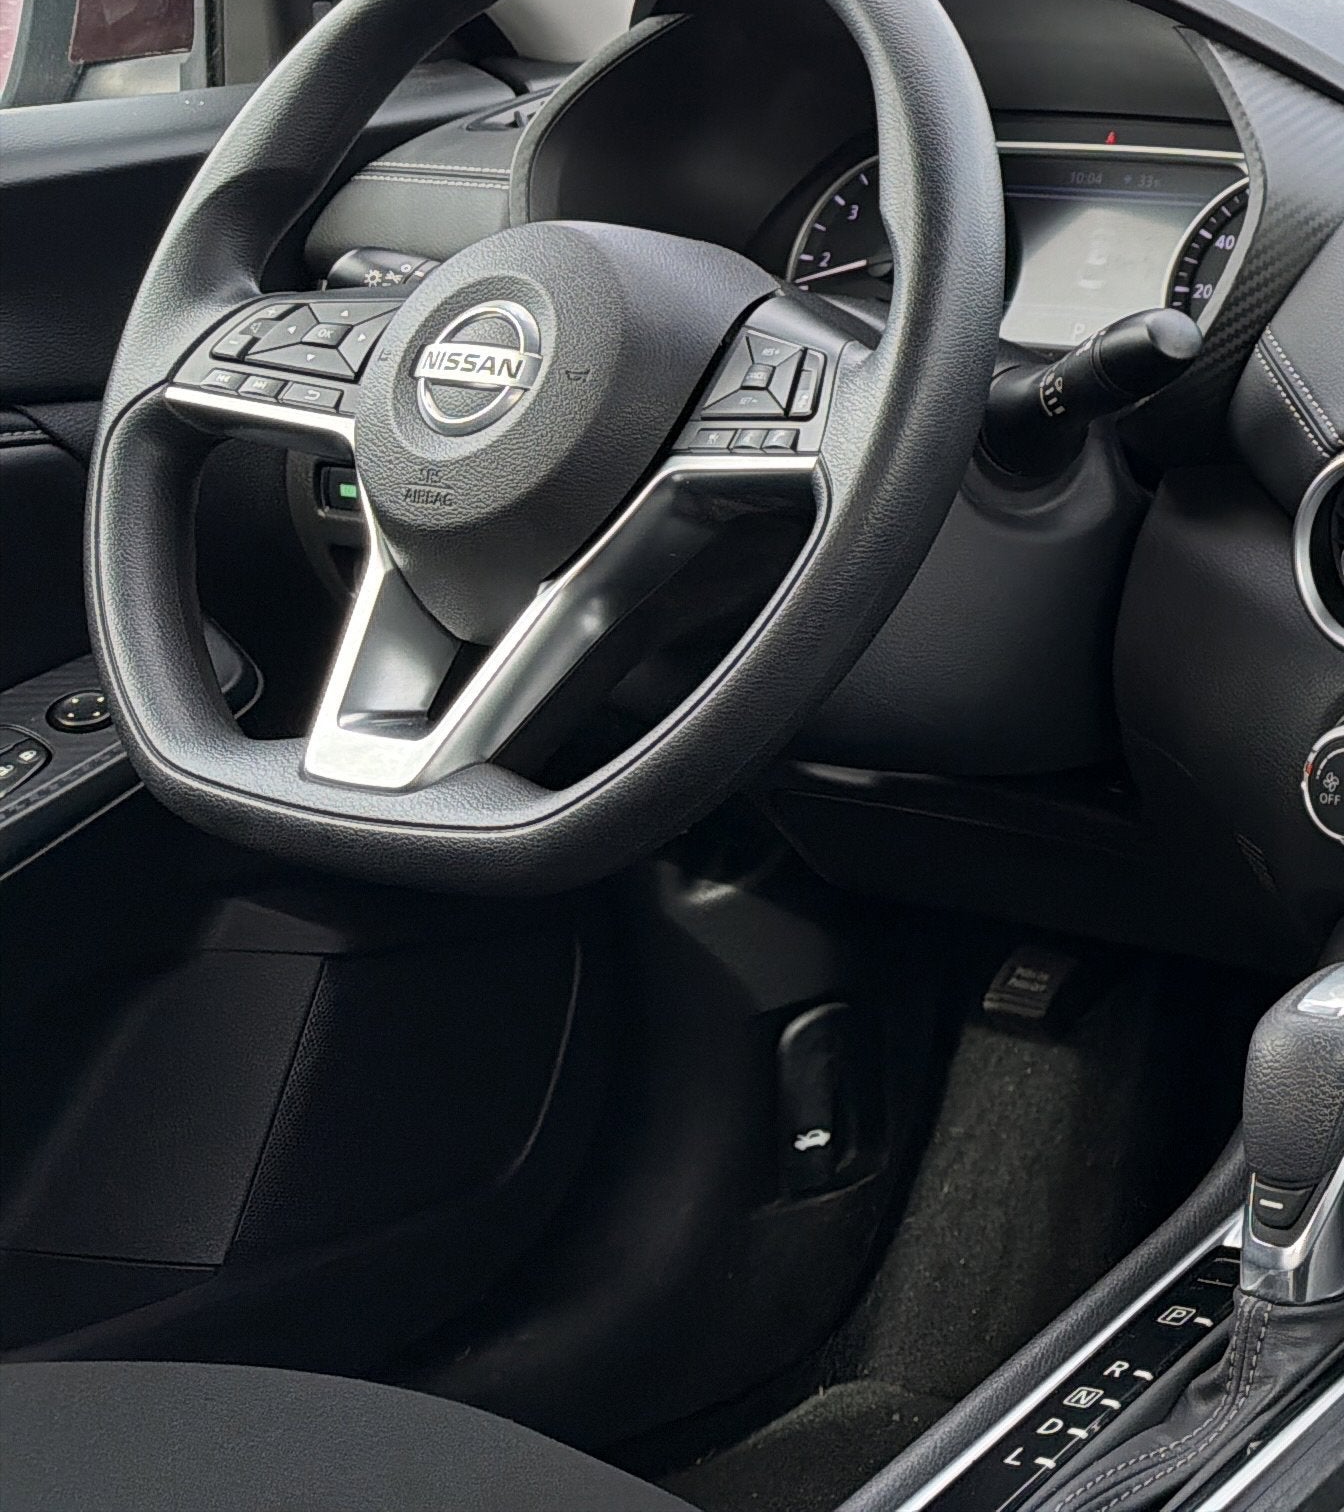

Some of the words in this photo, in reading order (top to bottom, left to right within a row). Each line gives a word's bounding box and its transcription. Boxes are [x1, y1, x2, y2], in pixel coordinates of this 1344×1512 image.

[847, 204, 859, 221] 3
[1215, 235, 1235, 250] 40
[819, 251, 831, 267] 2
[1192, 283, 1213, 299] 20
[317, 329, 333, 339] OK
[422, 351, 523, 379] NISSAN
[1319, 793, 1341, 806] OFF
[1104, 1361, 1130, 1378] R
[1036, 1418, 1062, 1435] D
[1003, 1447, 1025, 1465] L
